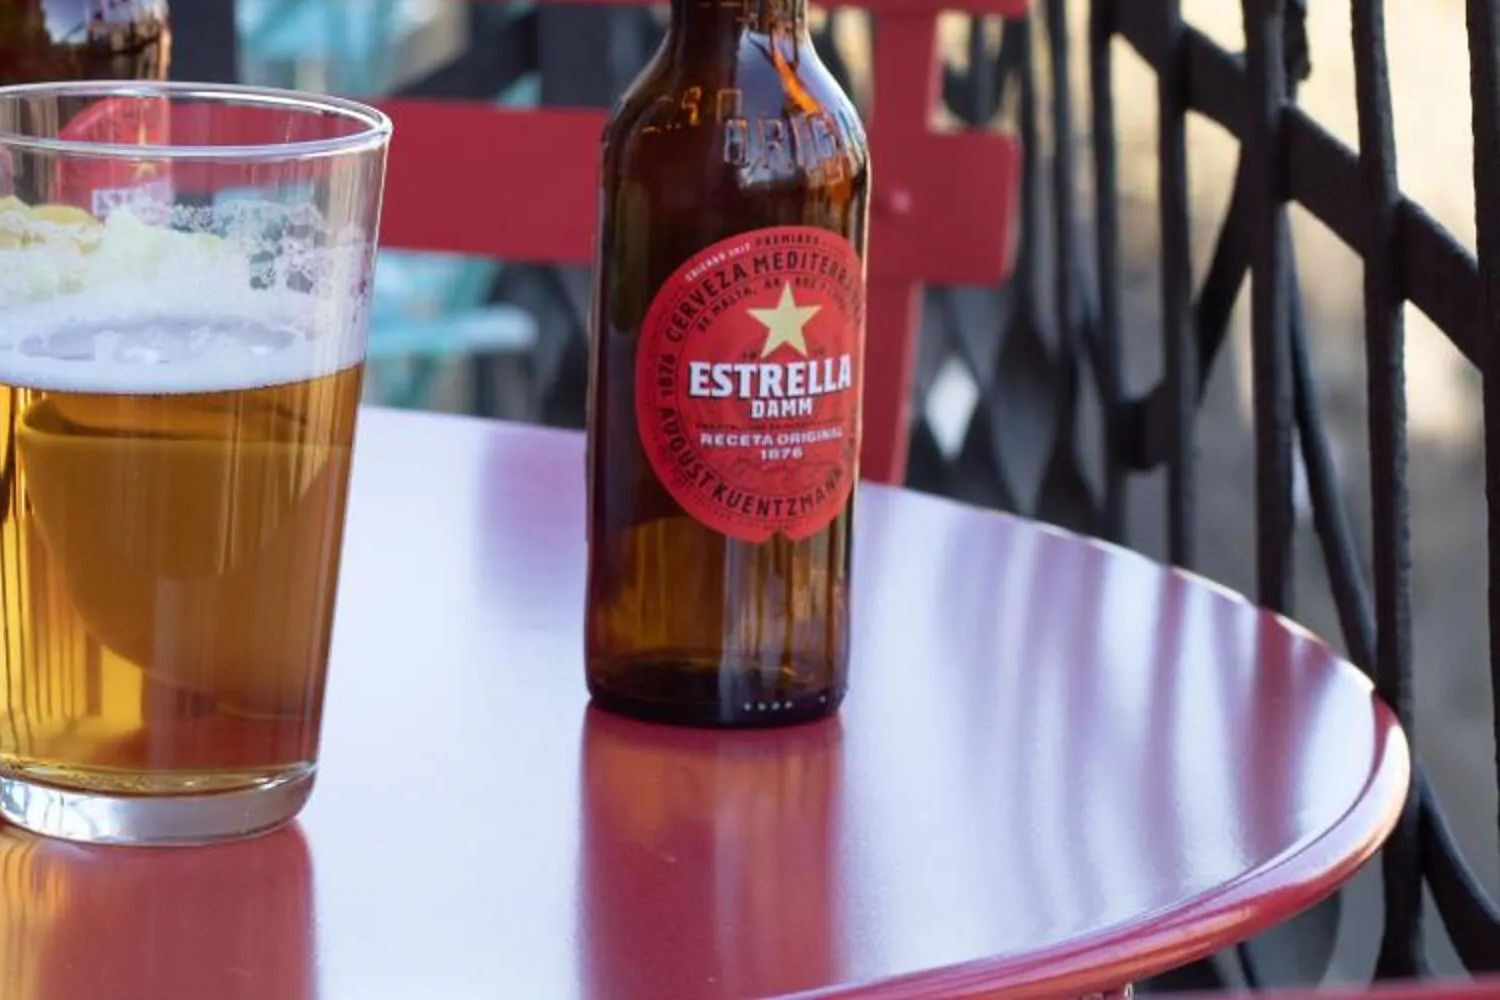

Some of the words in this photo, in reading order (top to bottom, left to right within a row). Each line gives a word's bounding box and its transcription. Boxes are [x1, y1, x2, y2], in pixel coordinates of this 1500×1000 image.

[666, 262, 748, 343] CERVEZA
[689, 353, 851, 399] ESTRELLA
[751, 398, 813, 419] DAMM
[700, 431, 773, 447] RECETA
[660, 407, 715, 489] AUGUST
[710, 462, 844, 518] KUENTZMANN
